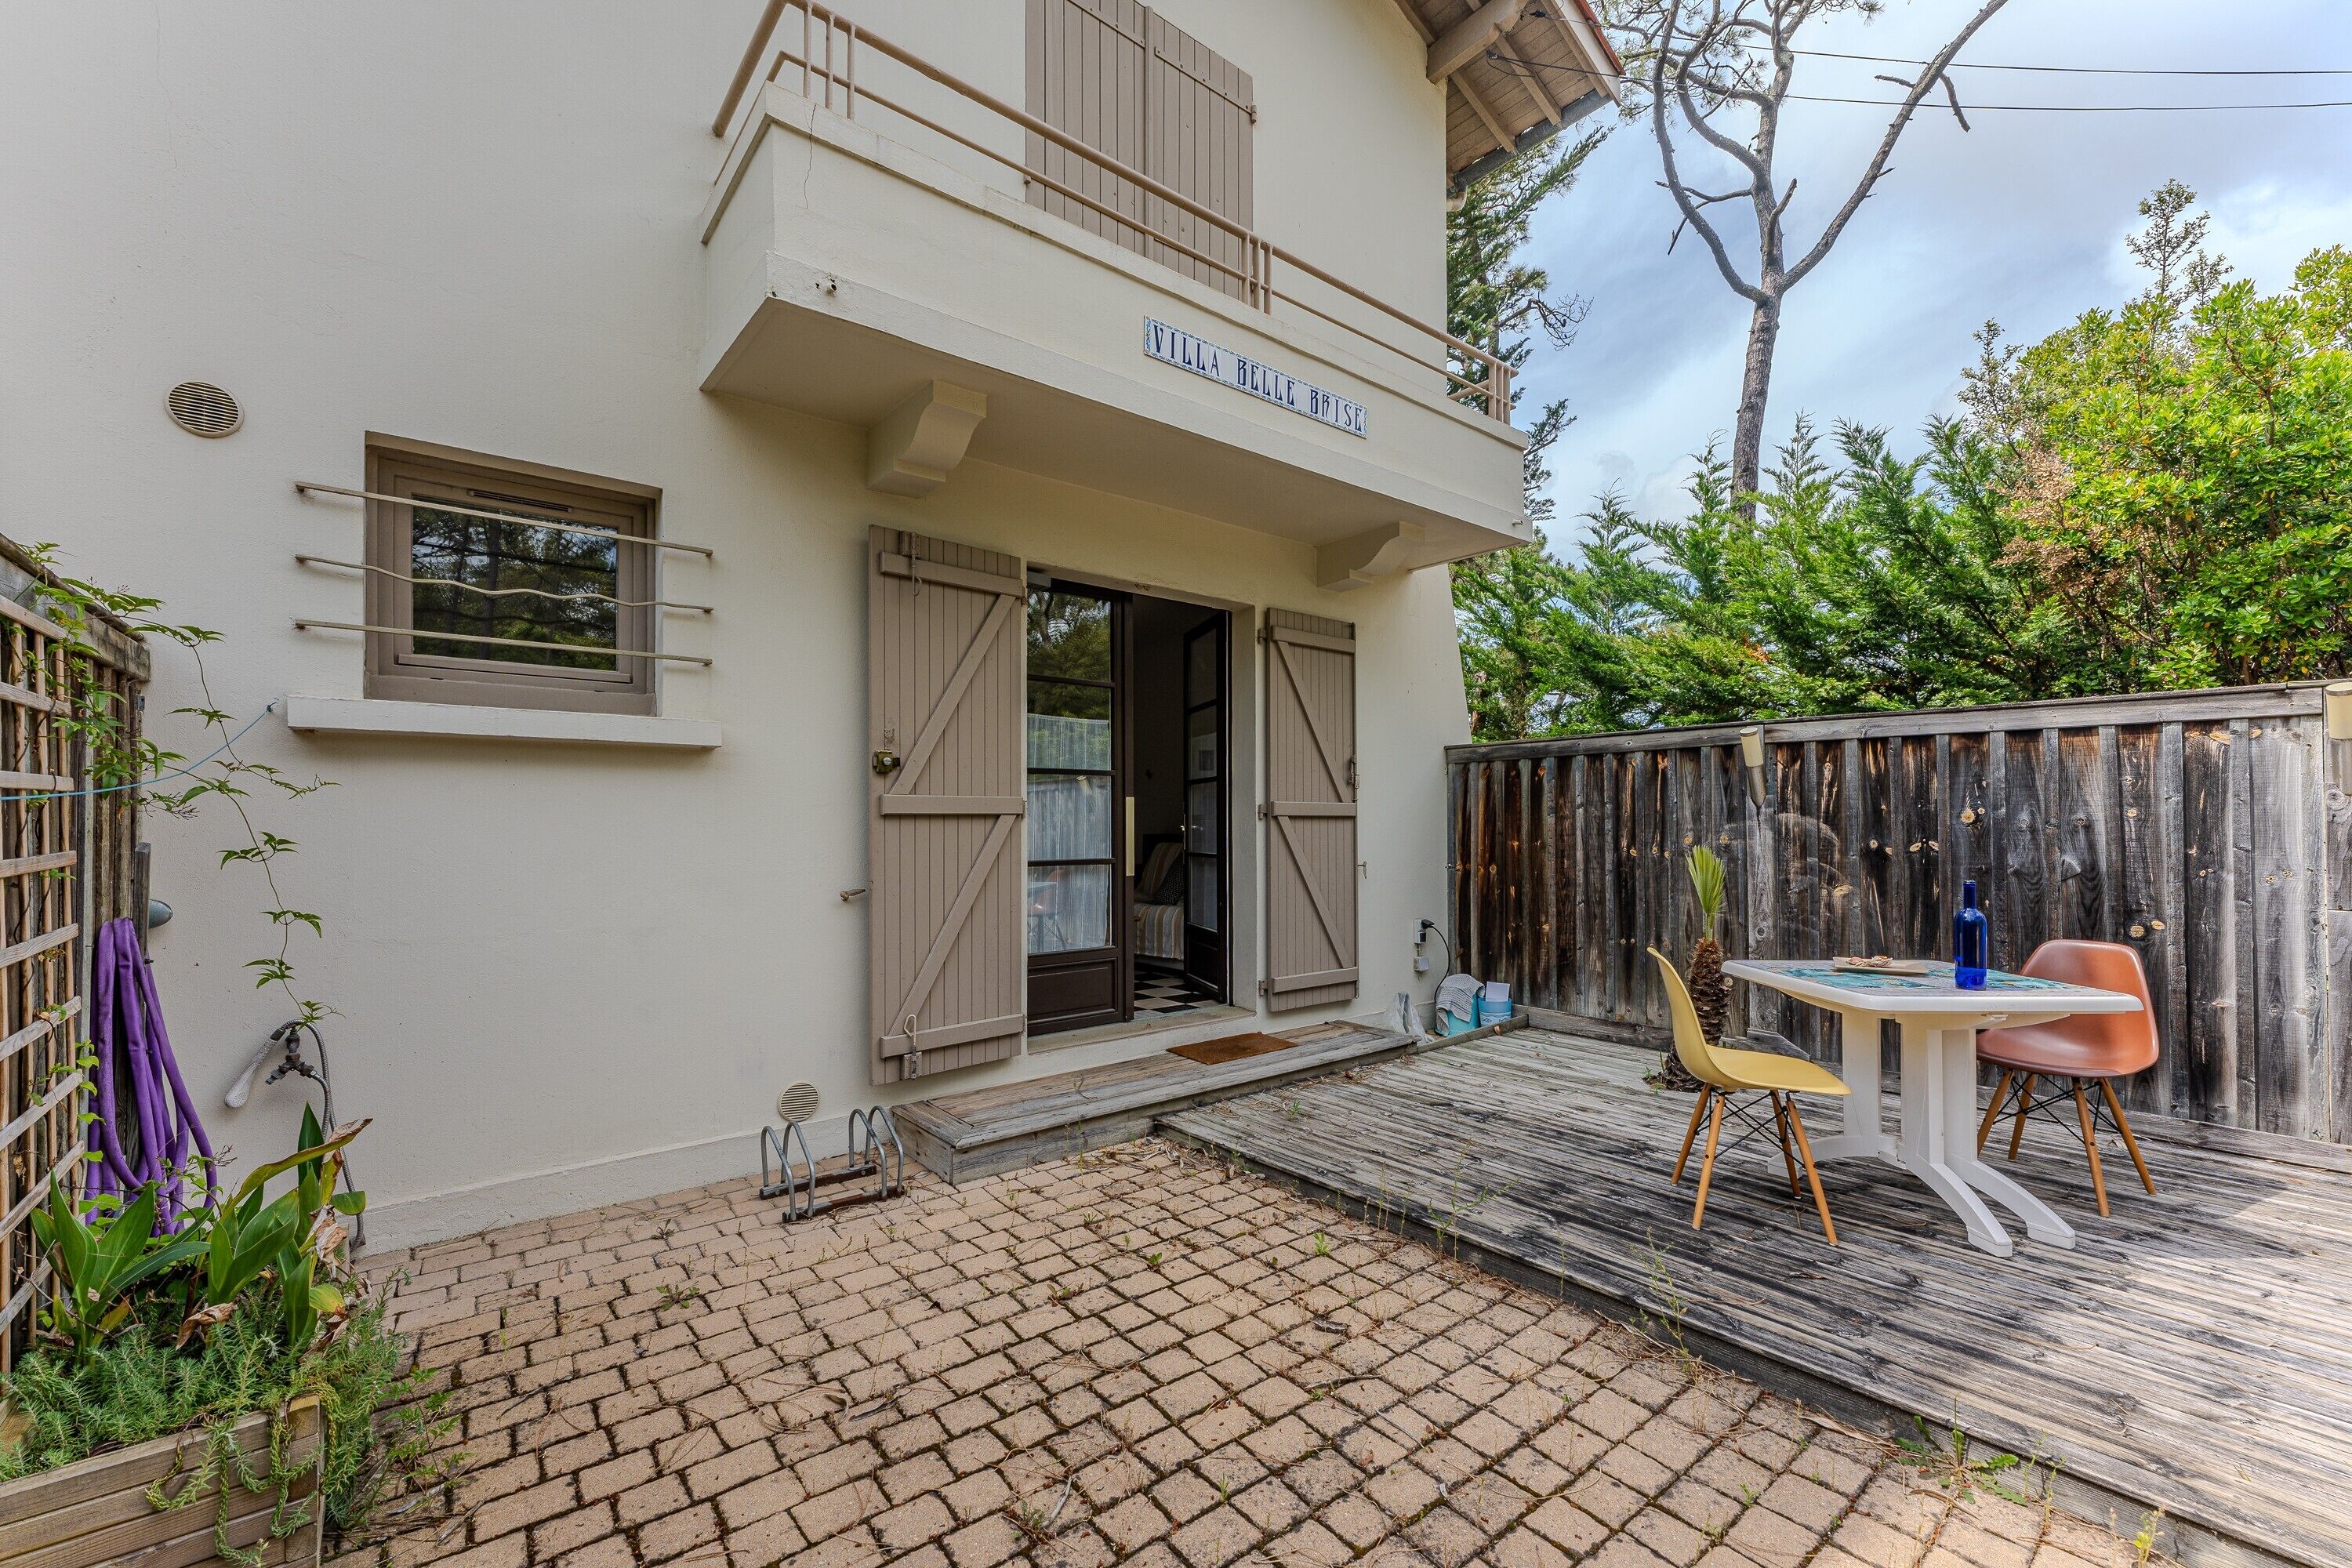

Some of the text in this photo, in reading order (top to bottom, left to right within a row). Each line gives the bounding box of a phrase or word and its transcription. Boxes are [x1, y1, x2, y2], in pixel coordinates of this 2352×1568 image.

[1153, 324, 1363, 432] VILLA BELLE BRISE
